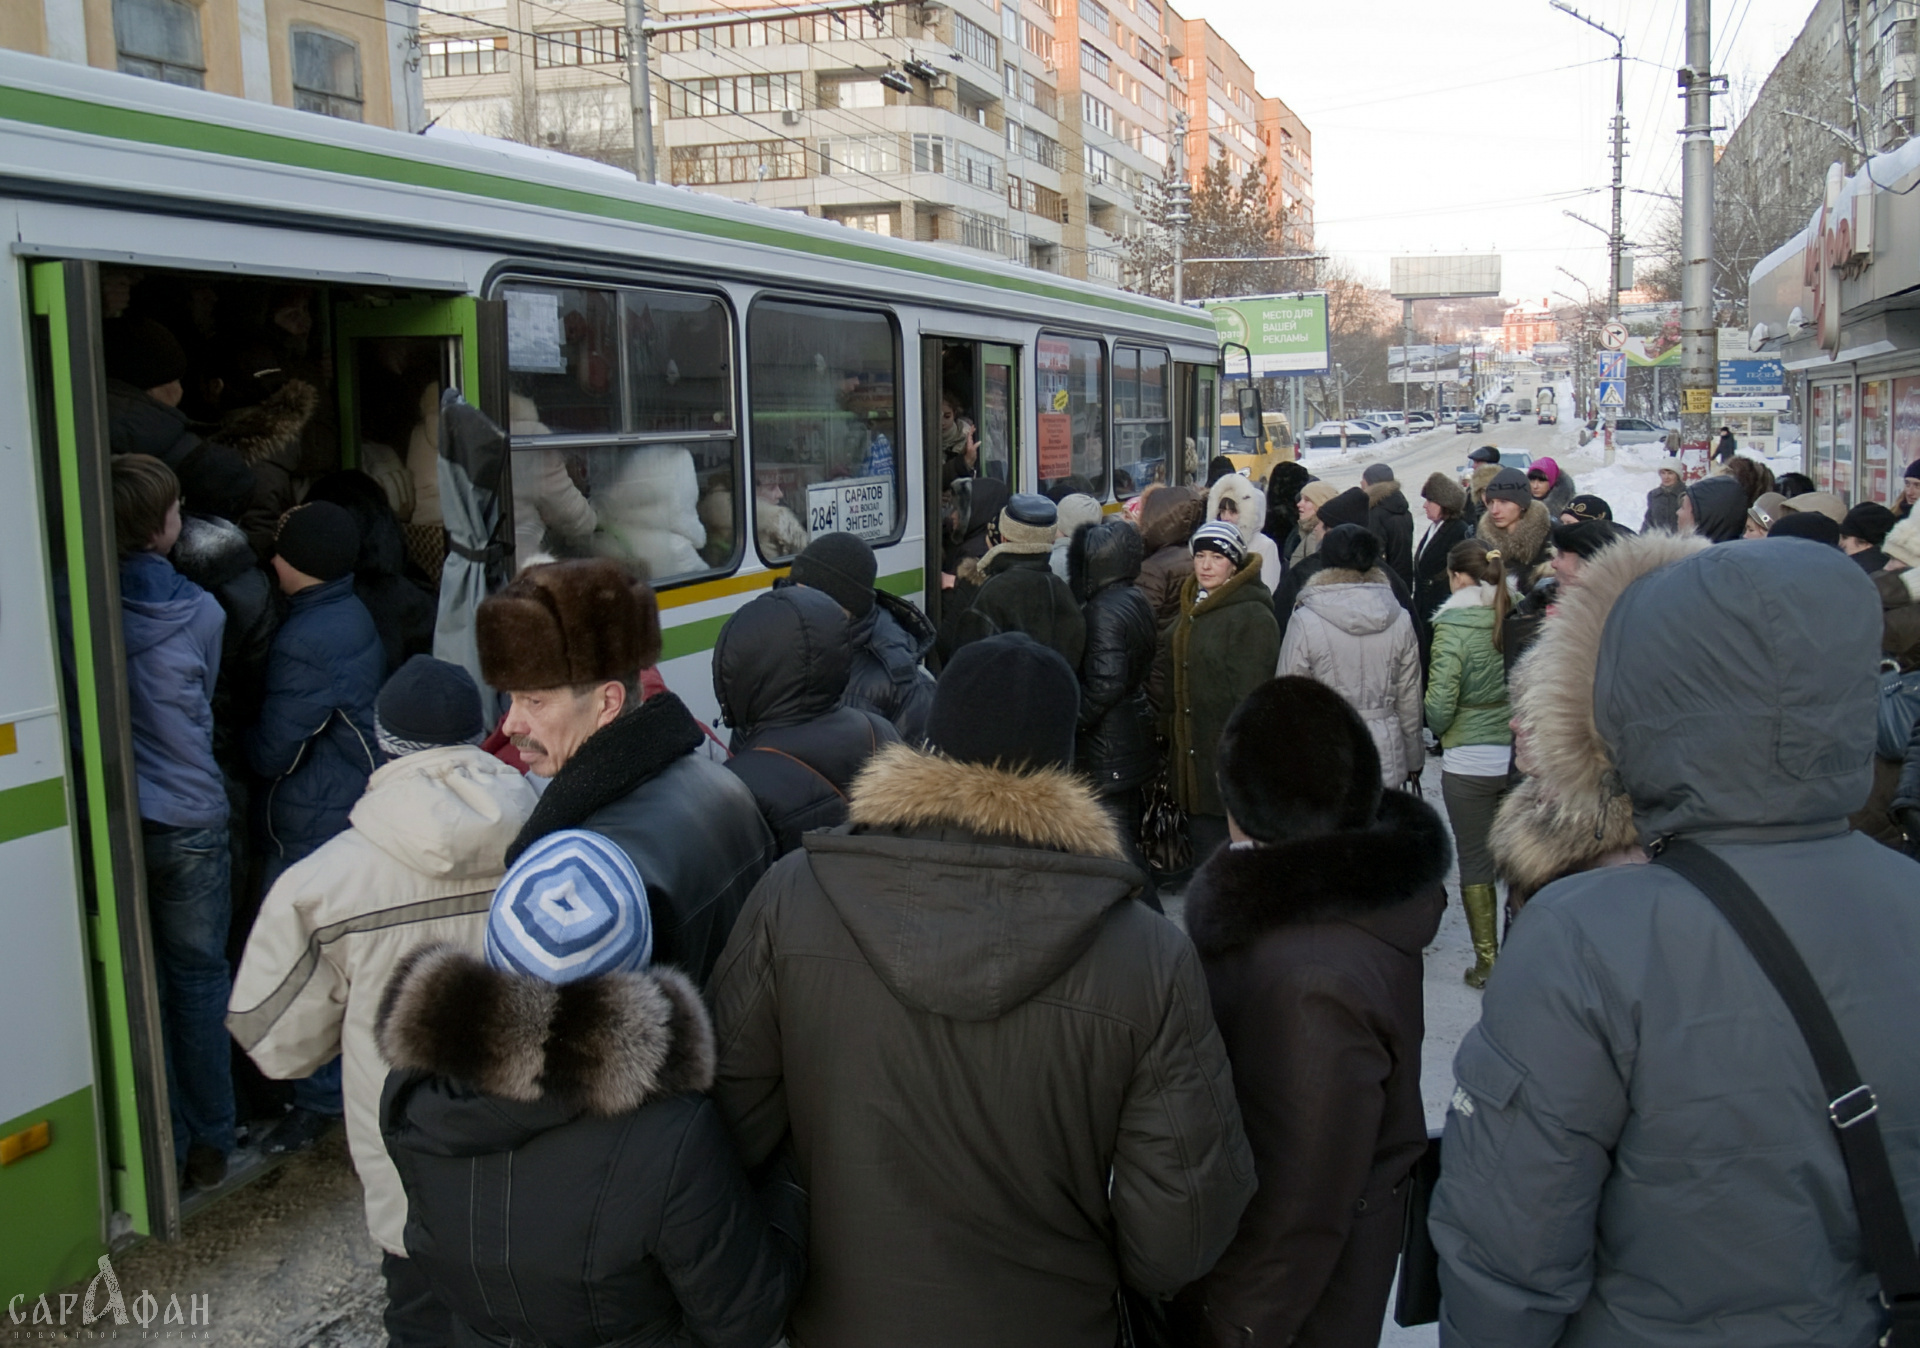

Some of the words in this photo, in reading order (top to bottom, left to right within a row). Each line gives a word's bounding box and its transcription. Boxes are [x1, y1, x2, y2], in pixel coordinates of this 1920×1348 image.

[1262, 309, 1293, 320] МЕСТО
[1293, 308, 1313, 320] ДЛЯ
[1262, 320, 1297, 332] ВАШЕЙ
[1262, 333, 1309, 344] РЕКЛАМЫ
[845, 485, 883, 503] САРАТОВ
[860, 502, 879, 513] ВОКЗАЛ
[846, 512, 884, 531] ЭНГЕЛЬС
